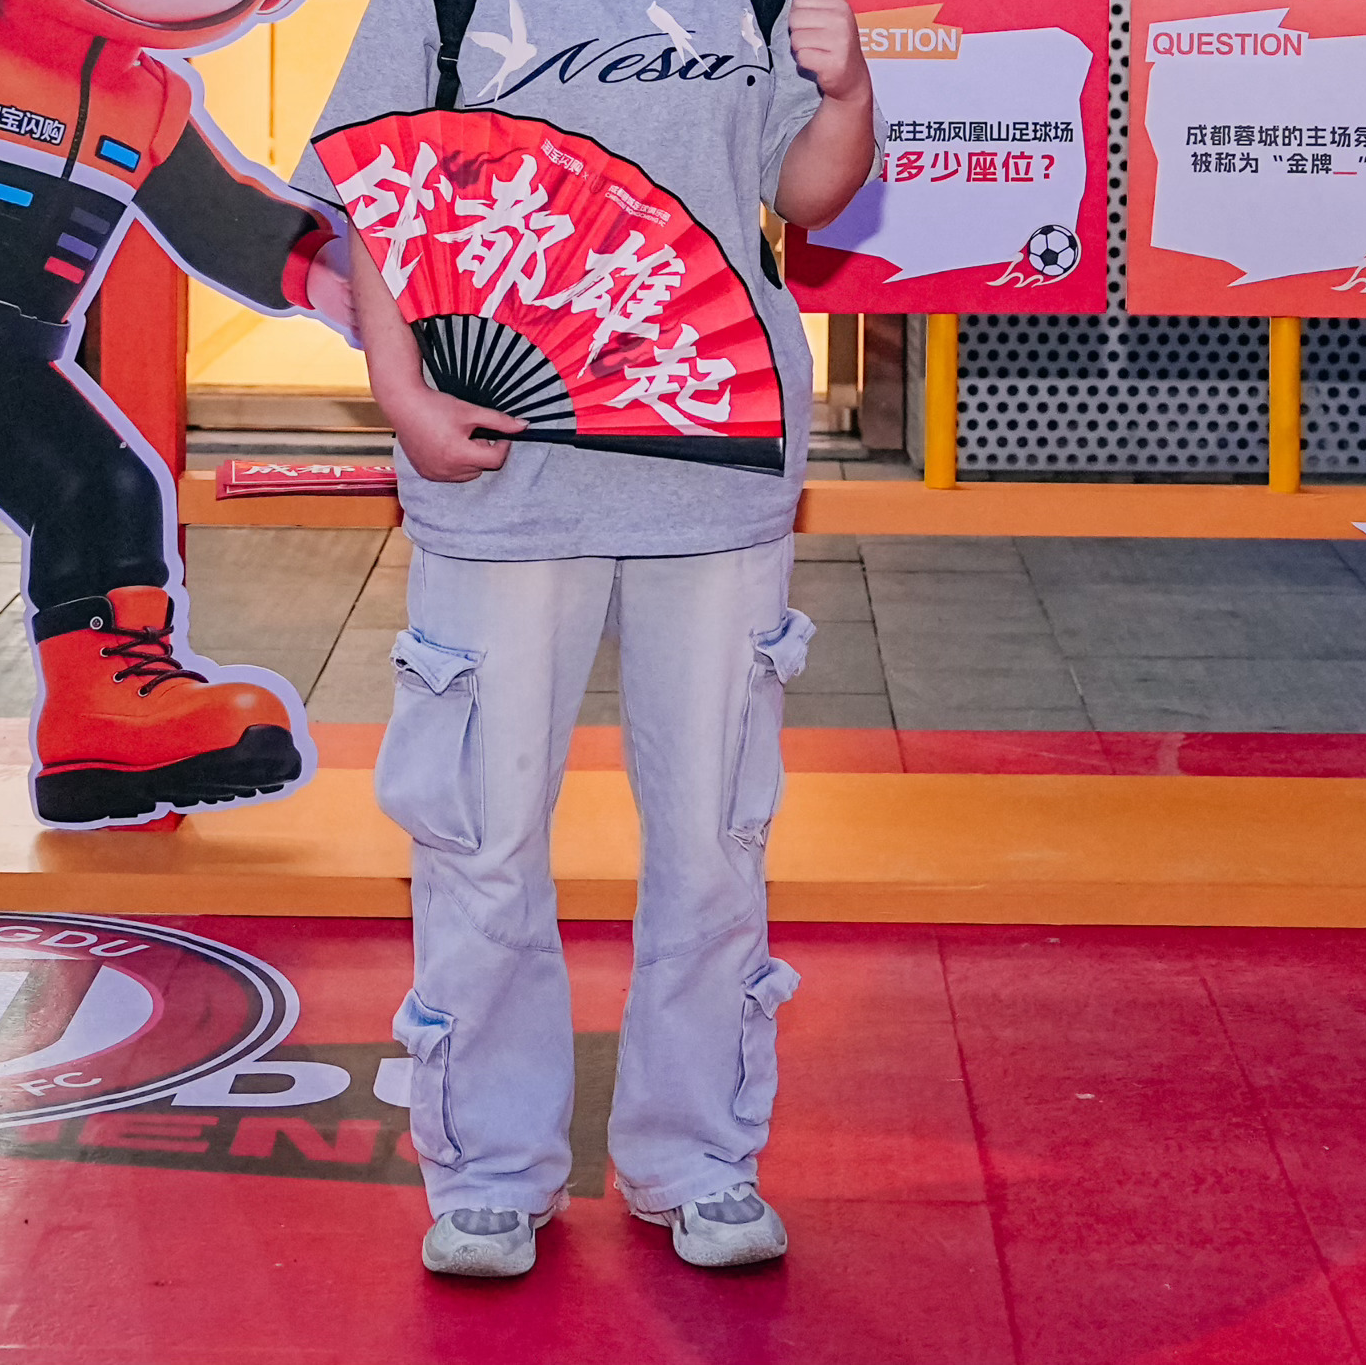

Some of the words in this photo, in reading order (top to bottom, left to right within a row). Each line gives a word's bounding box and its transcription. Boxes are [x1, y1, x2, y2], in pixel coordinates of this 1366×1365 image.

[859, 27, 957, 53] ESTION
[1152, 33, 1303, 58] QUESTION
[540, 138, 585, 176] 淘宝闪购
[335, 140, 737, 438] 成都雄起
[17, 1069, 103, 1098] FC
